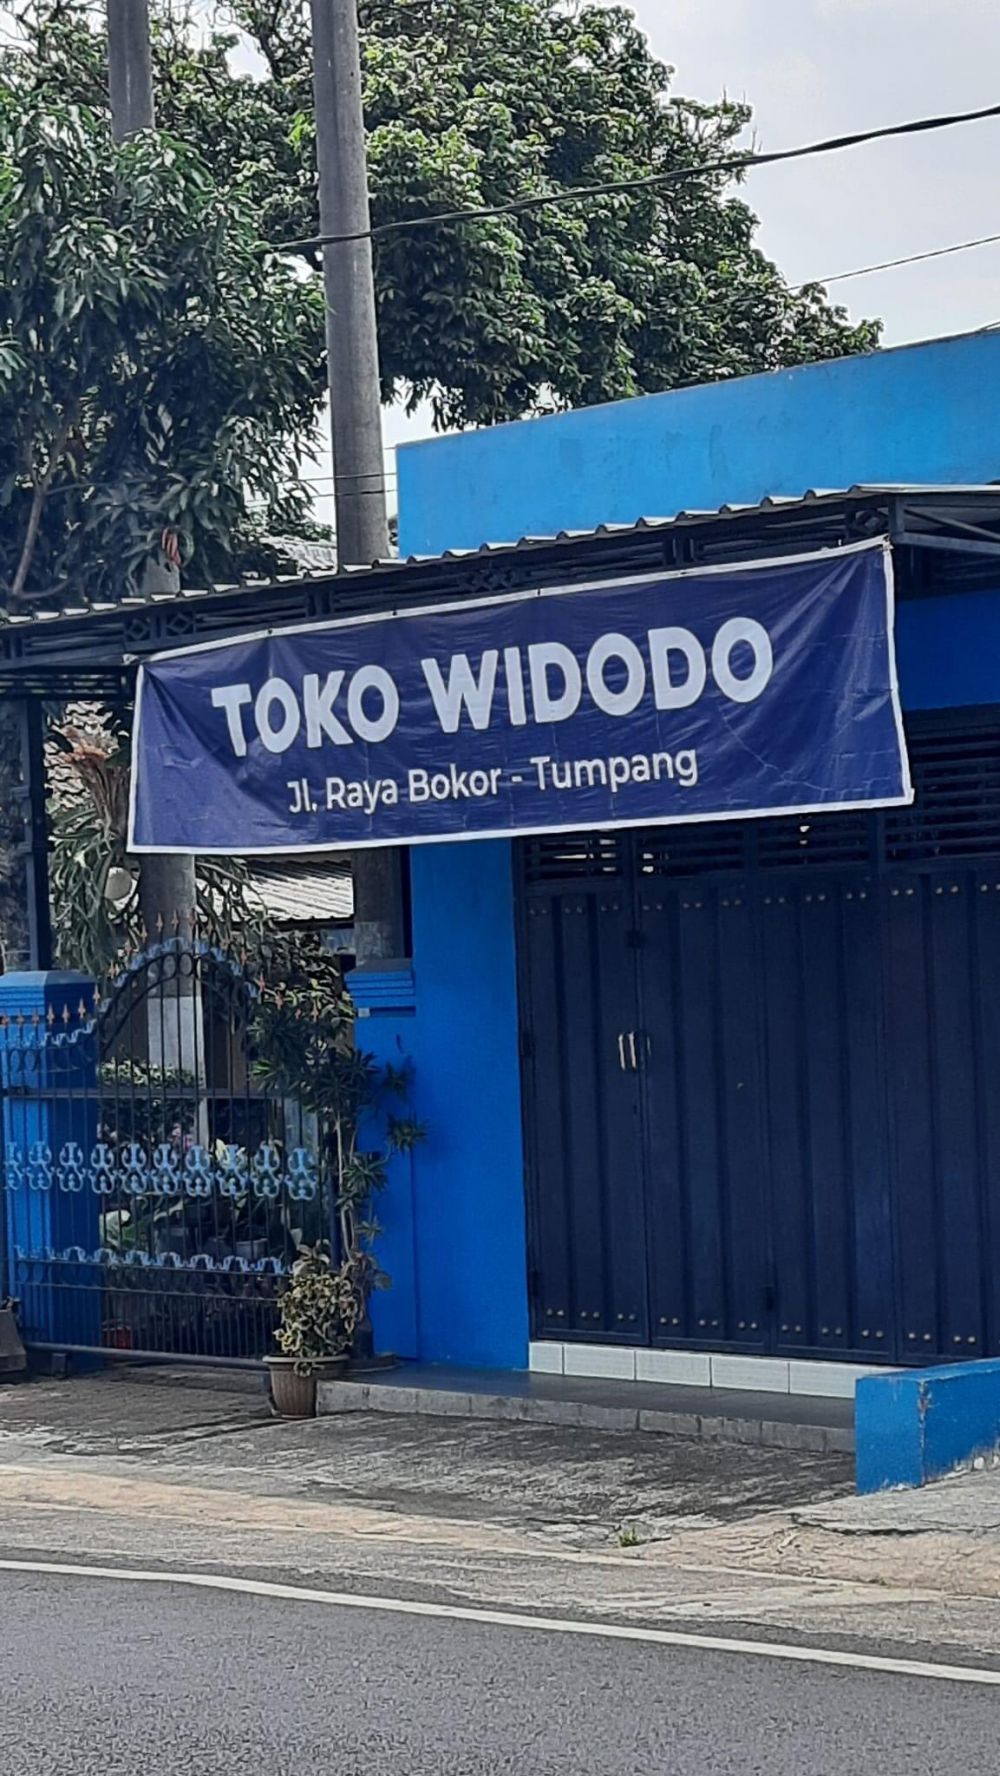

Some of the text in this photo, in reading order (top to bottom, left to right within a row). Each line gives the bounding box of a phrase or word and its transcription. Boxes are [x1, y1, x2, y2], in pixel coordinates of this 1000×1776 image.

[211, 617, 774, 757] TOKO WIDODO
[287, 779, 318, 814] Jl.
[325, 777, 400, 815] Raya
[408, 763, 502, 802] Bokor
[530, 748, 699, 793] Tumpang
